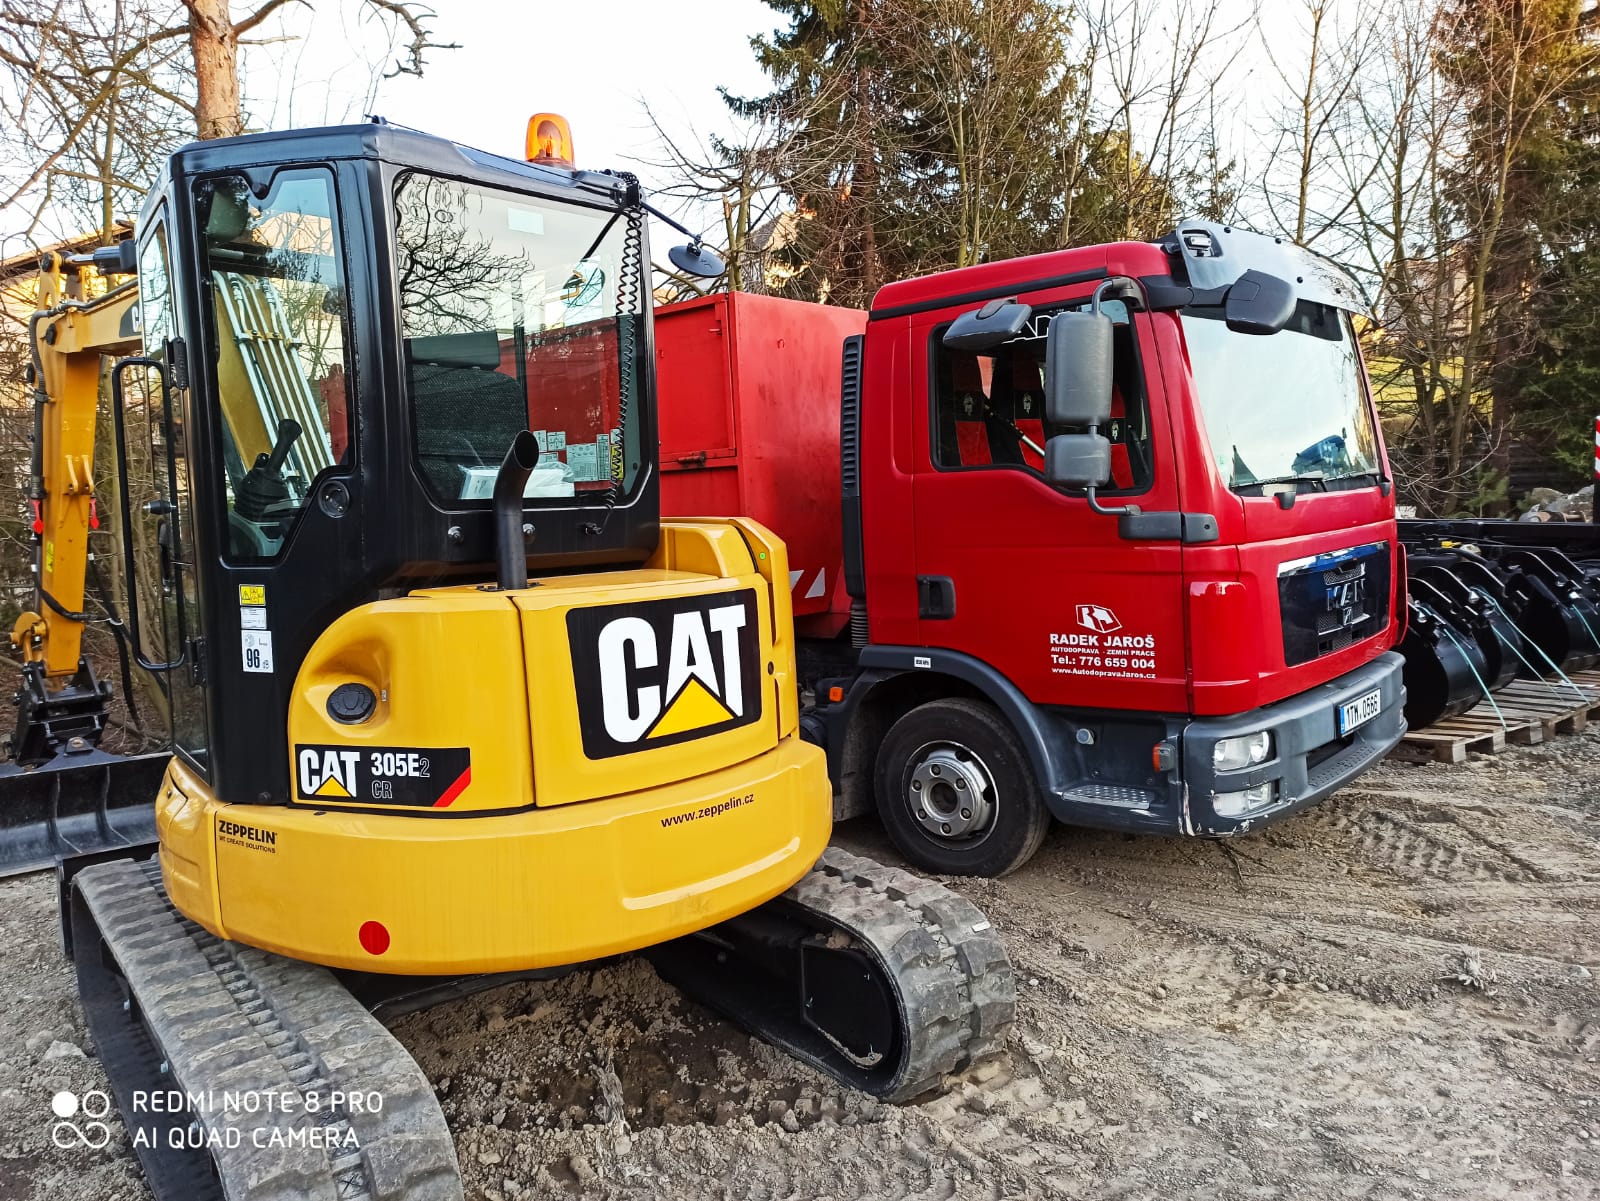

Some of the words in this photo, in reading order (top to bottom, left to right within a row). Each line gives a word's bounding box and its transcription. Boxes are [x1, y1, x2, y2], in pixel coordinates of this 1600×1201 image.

[1050, 633, 1099, 646] RADEK
[1103, 634, 1155, 648] JAROŠ
[1050, 646, 1099, 654] AUTODOPRAVA
[246, 648, 260, 668] 96
[1051, 654, 1076, 665] Tel.:
[1080, 656, 1101, 665] 776
[1104, 658, 1128, 667] 659
[1131, 659, 1155, 669] 004
[598, 604, 747, 743] CAT
[1052, 667, 1156, 678] www.AutodopravaJaros.cz
[299, 749, 361, 797] CAT
[371, 780, 392, 799] CR
[660, 793, 755, 827] www.zeppelin.cz
[218, 820, 277, 844] ZEPPELIN
[226, 838, 244, 846] CREATE
[245, 843, 276, 852] SOLUTIONS
